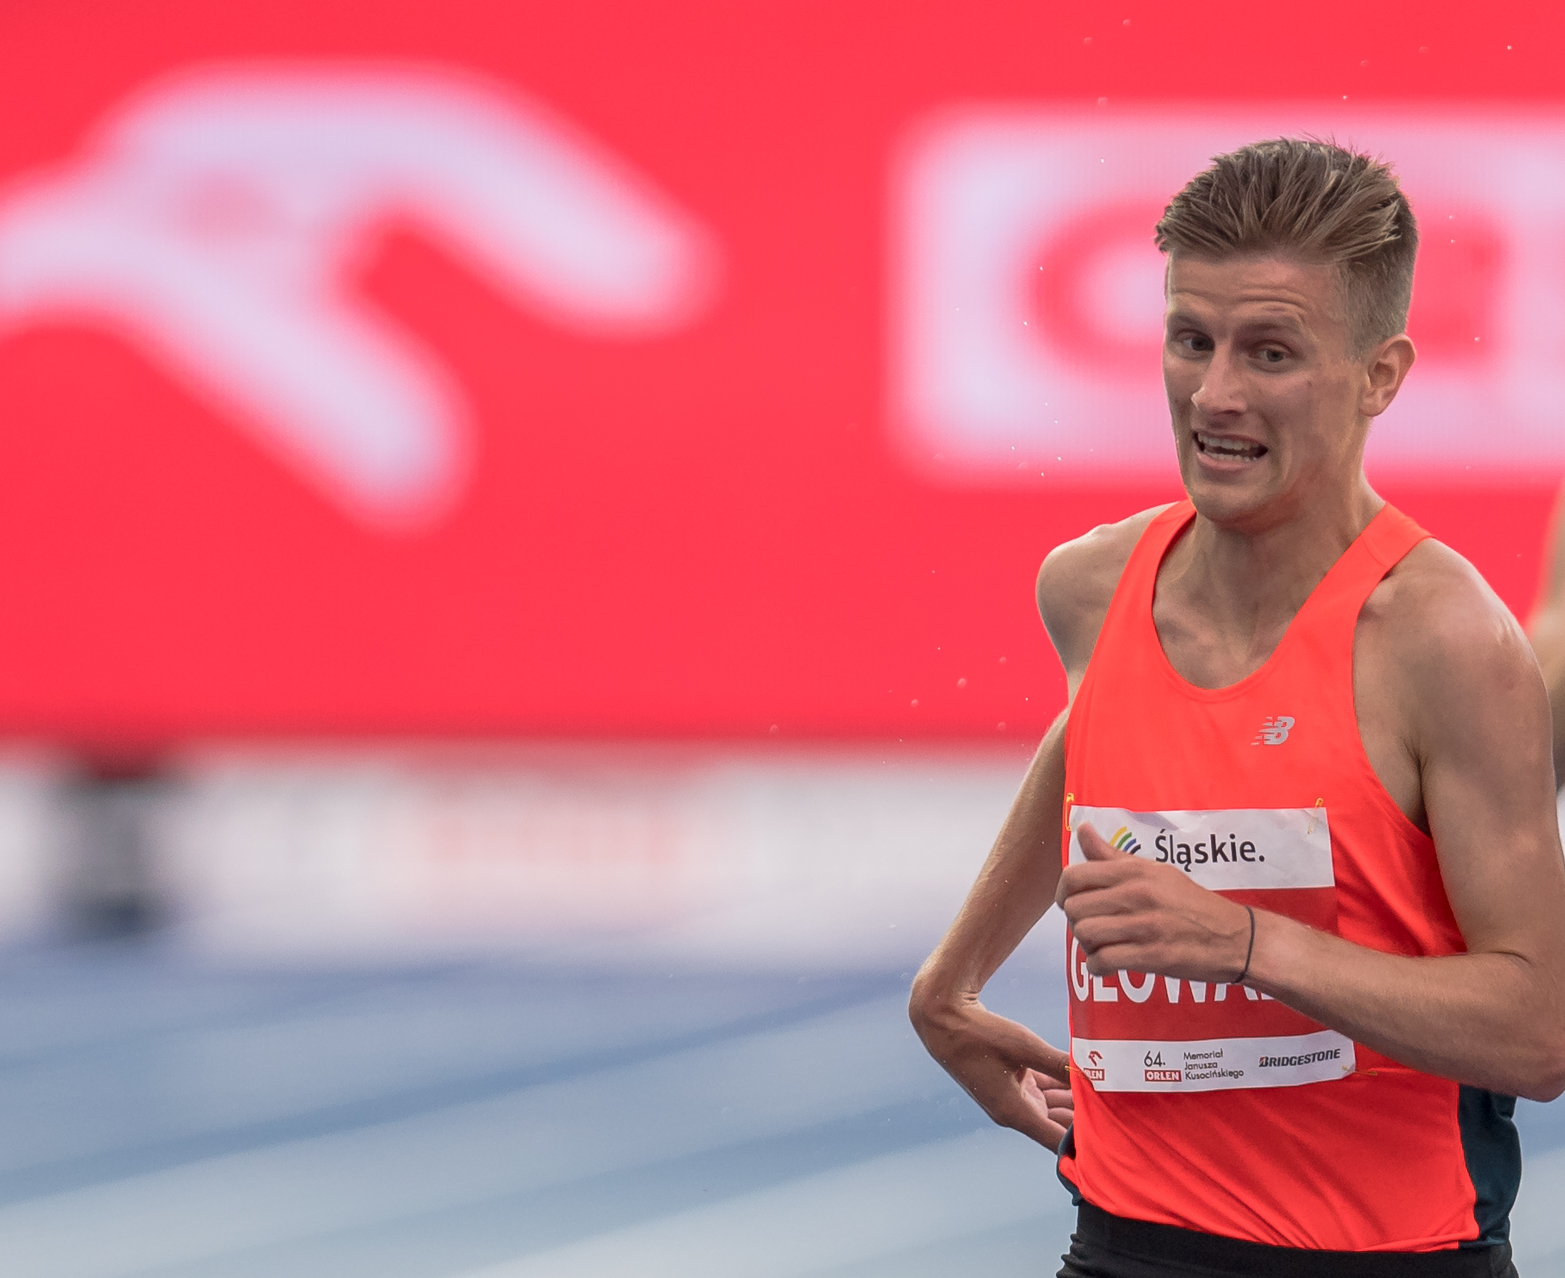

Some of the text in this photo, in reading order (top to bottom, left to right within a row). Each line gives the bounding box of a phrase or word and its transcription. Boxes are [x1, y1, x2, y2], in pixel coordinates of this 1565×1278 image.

[1155, 828, 1265, 873] Śląskie.
[1143, 1050, 1167, 1068] 64.
[1184, 1061, 1218, 1071] Janusza
[1259, 1048, 1341, 1068] BRIDGESTONE
[1146, 1071, 1180, 1081] ORLEN
